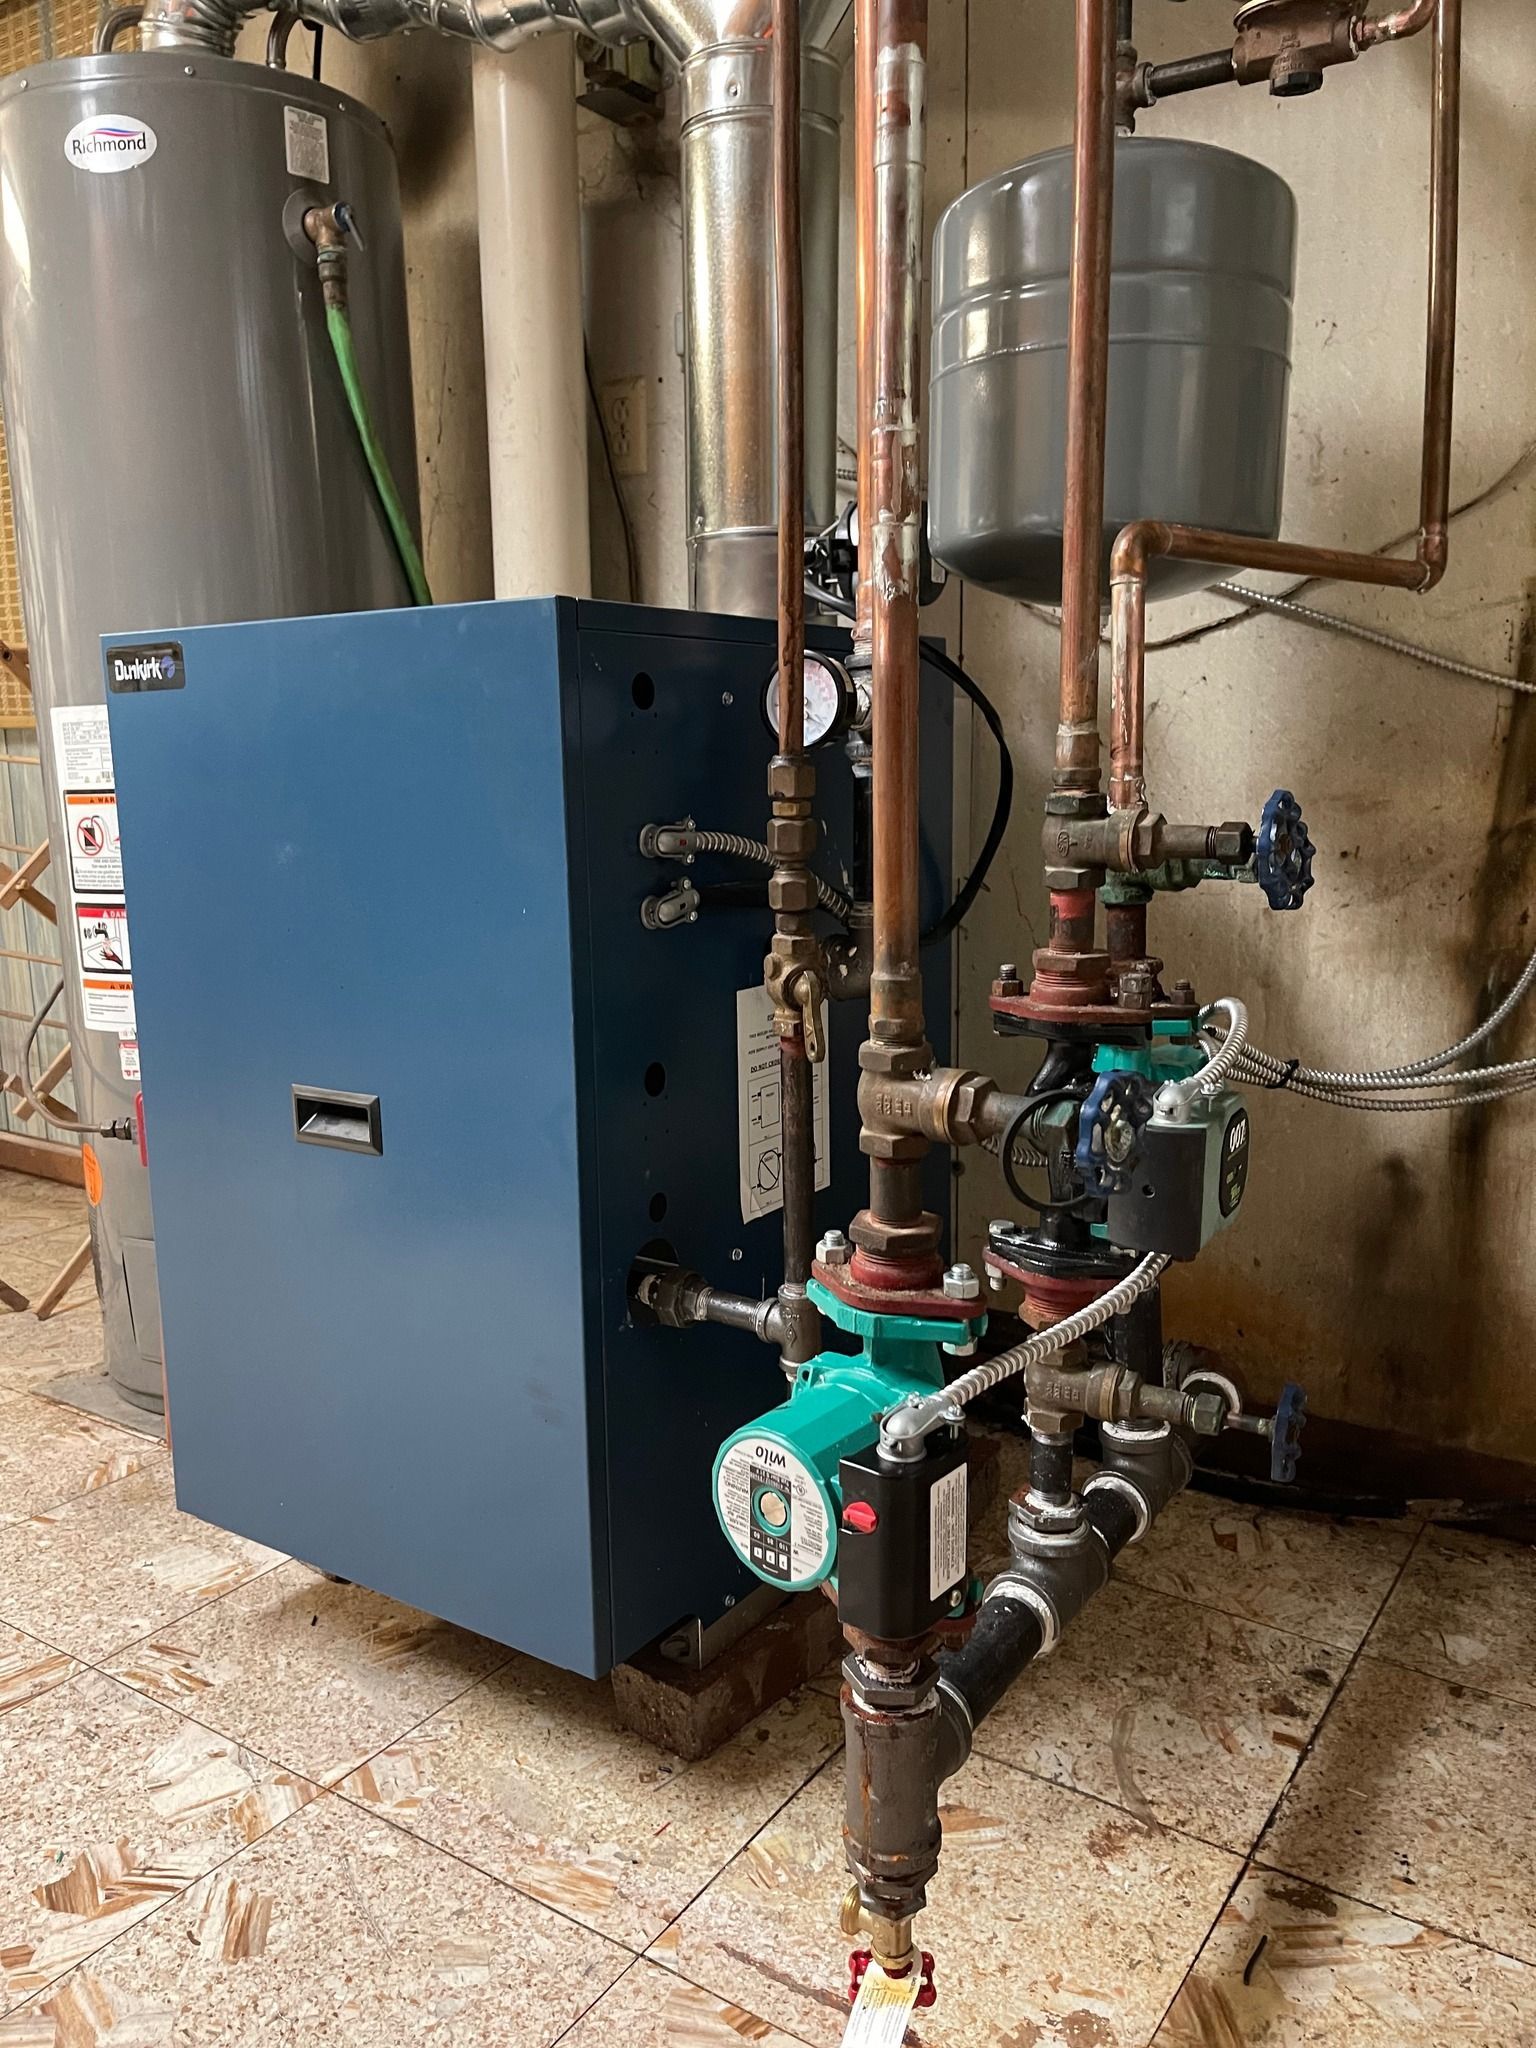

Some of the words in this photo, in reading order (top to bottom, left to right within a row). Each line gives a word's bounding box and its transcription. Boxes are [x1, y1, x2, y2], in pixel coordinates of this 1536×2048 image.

[72, 132, 147, 155] Richmond
[114, 657, 163, 681] Dunkirk
[755, 1446, 786, 1468] wilo
